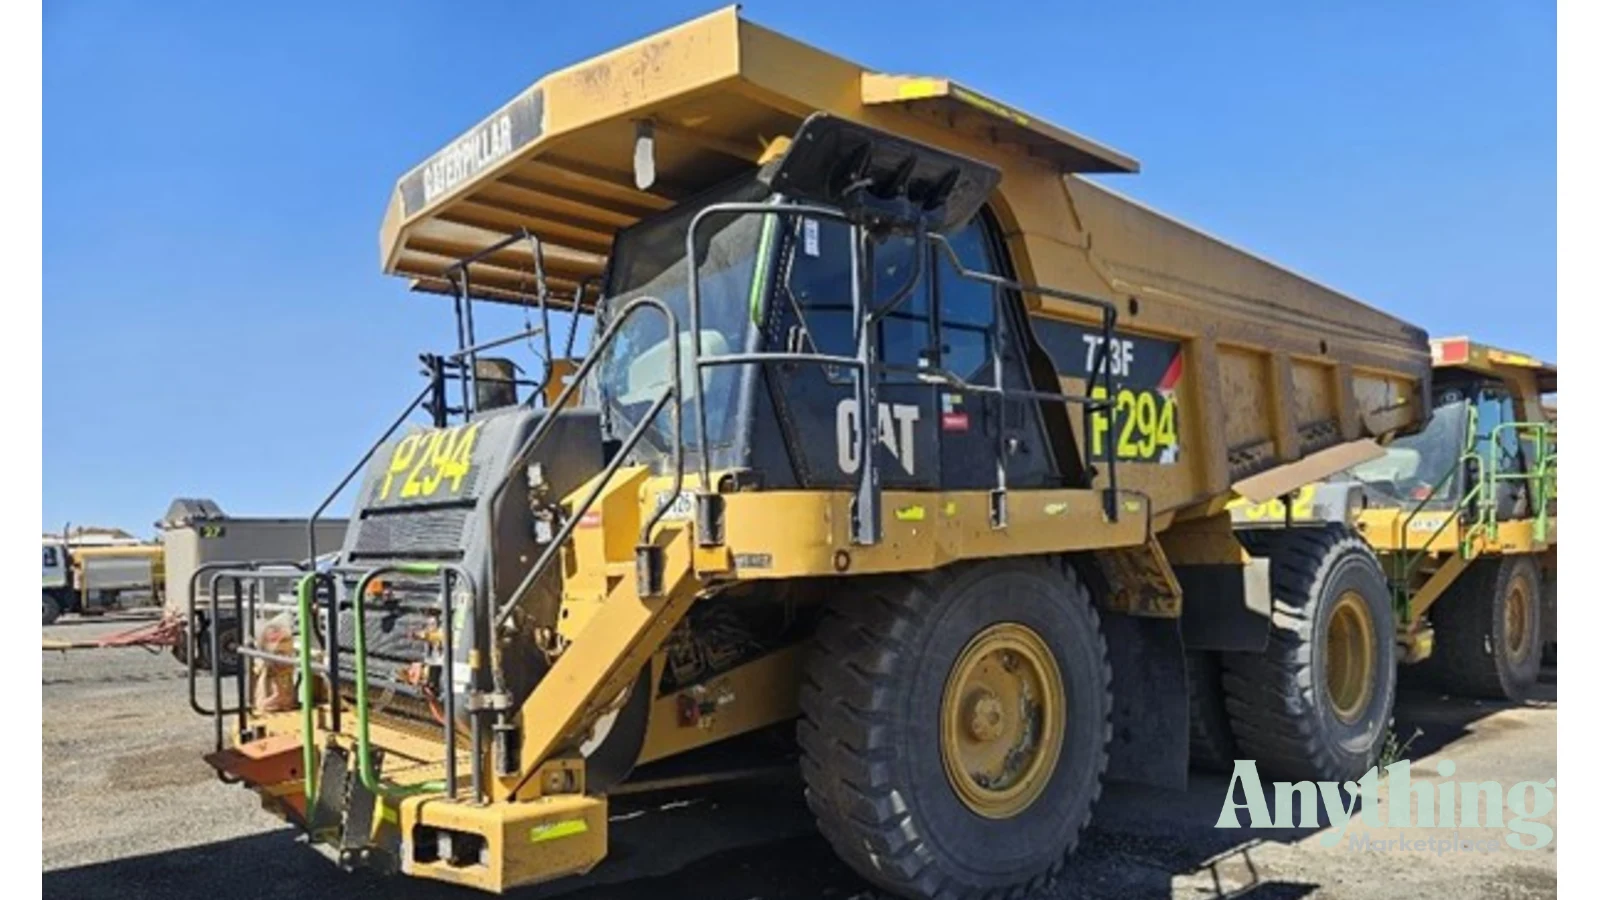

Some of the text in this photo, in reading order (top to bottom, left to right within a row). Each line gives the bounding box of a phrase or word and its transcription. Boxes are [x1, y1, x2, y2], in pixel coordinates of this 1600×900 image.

[423, 115, 512, 202] CATERPILLAR
[380, 422, 479, 500] P294
[837, 398, 919, 475] CAT
[1091, 388, 1177, 458] P294
